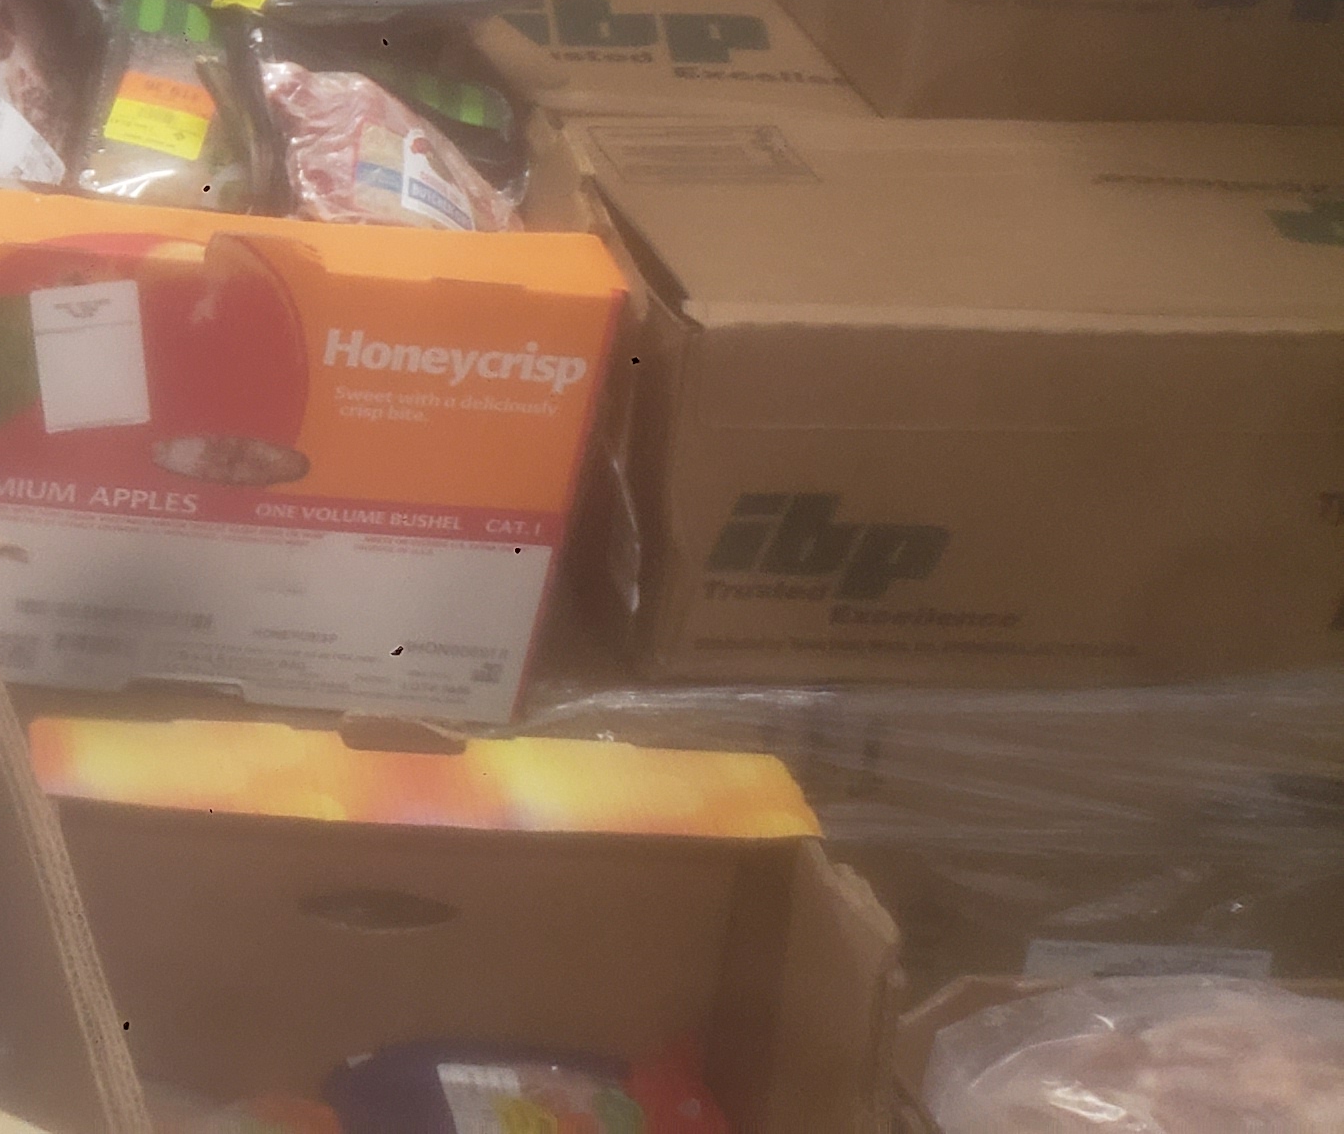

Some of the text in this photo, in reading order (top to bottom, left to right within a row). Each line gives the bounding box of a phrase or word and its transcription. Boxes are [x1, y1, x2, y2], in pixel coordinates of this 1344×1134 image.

[323, 328, 587, 393] Honeycrisp
[397, 391, 441, 408] with
[443, 396, 456, 408] a
[90, 486, 199, 514] APPLES
[255, 502, 297, 520] ONE
[301, 506, 386, 525] VOLUME
[390, 512, 463, 531] BUSHEL
[485, 519, 530, 537] CAT.
[705, 490, 952, 601] ibp
[704, 578, 831, 601] Trusted
[829, 604, 1023, 628] Excellence
